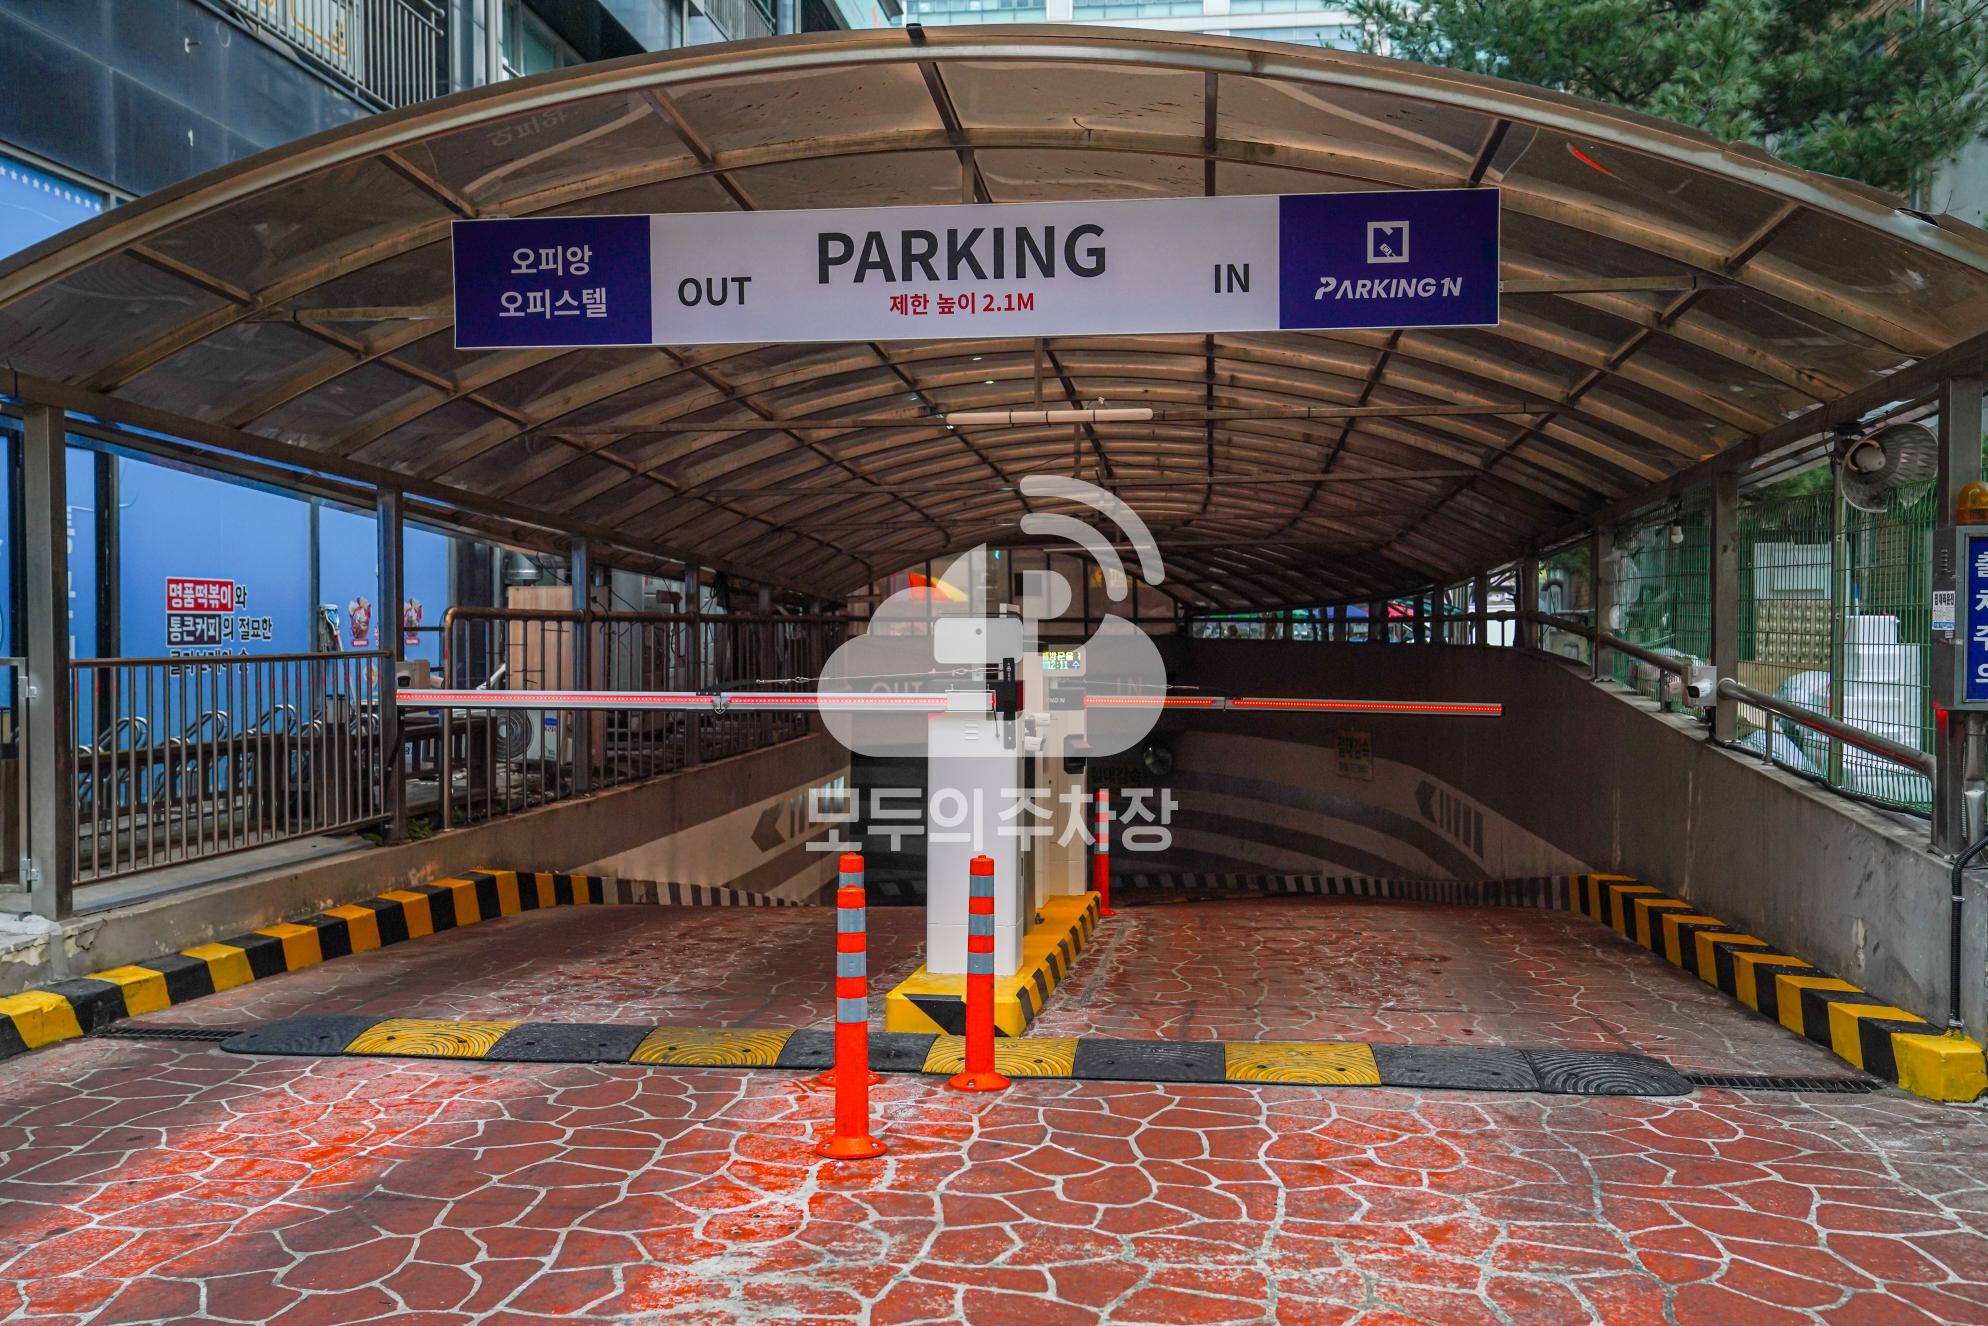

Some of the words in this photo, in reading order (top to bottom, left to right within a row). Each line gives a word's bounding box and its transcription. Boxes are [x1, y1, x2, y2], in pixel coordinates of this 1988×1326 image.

[511, 245, 592, 276] 오피앙
[817, 224, 1106, 284] PARKING
[678, 276, 752, 306] OUT
[1214, 264, 1250, 293] IN
[1315, 277, 1437, 300] PARKING
[499, 287, 607, 320] 오피스텔
[889, 293, 930, 316] 제한
[937, 292, 976, 315] 높이
[983, 292, 1034, 312] 2.1M
[239, 617, 273, 641] 절묘한
